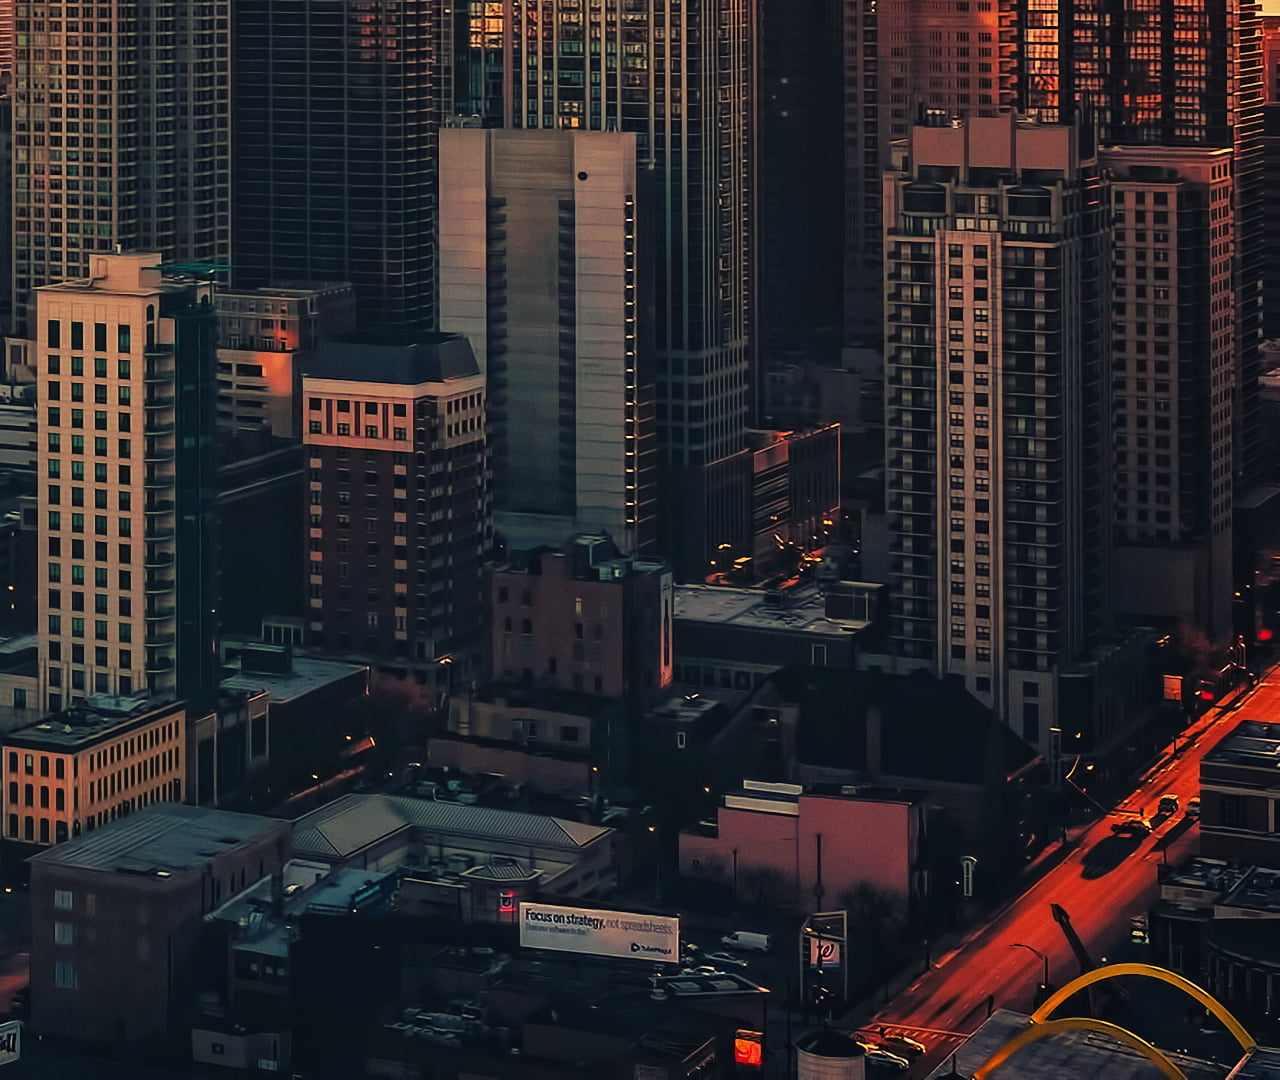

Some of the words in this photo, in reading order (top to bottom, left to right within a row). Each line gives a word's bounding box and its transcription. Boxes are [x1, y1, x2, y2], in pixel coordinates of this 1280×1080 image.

[525, 908, 552, 923] Focus
[553, 914, 565, 924] on
[606, 919, 619, 929] not
